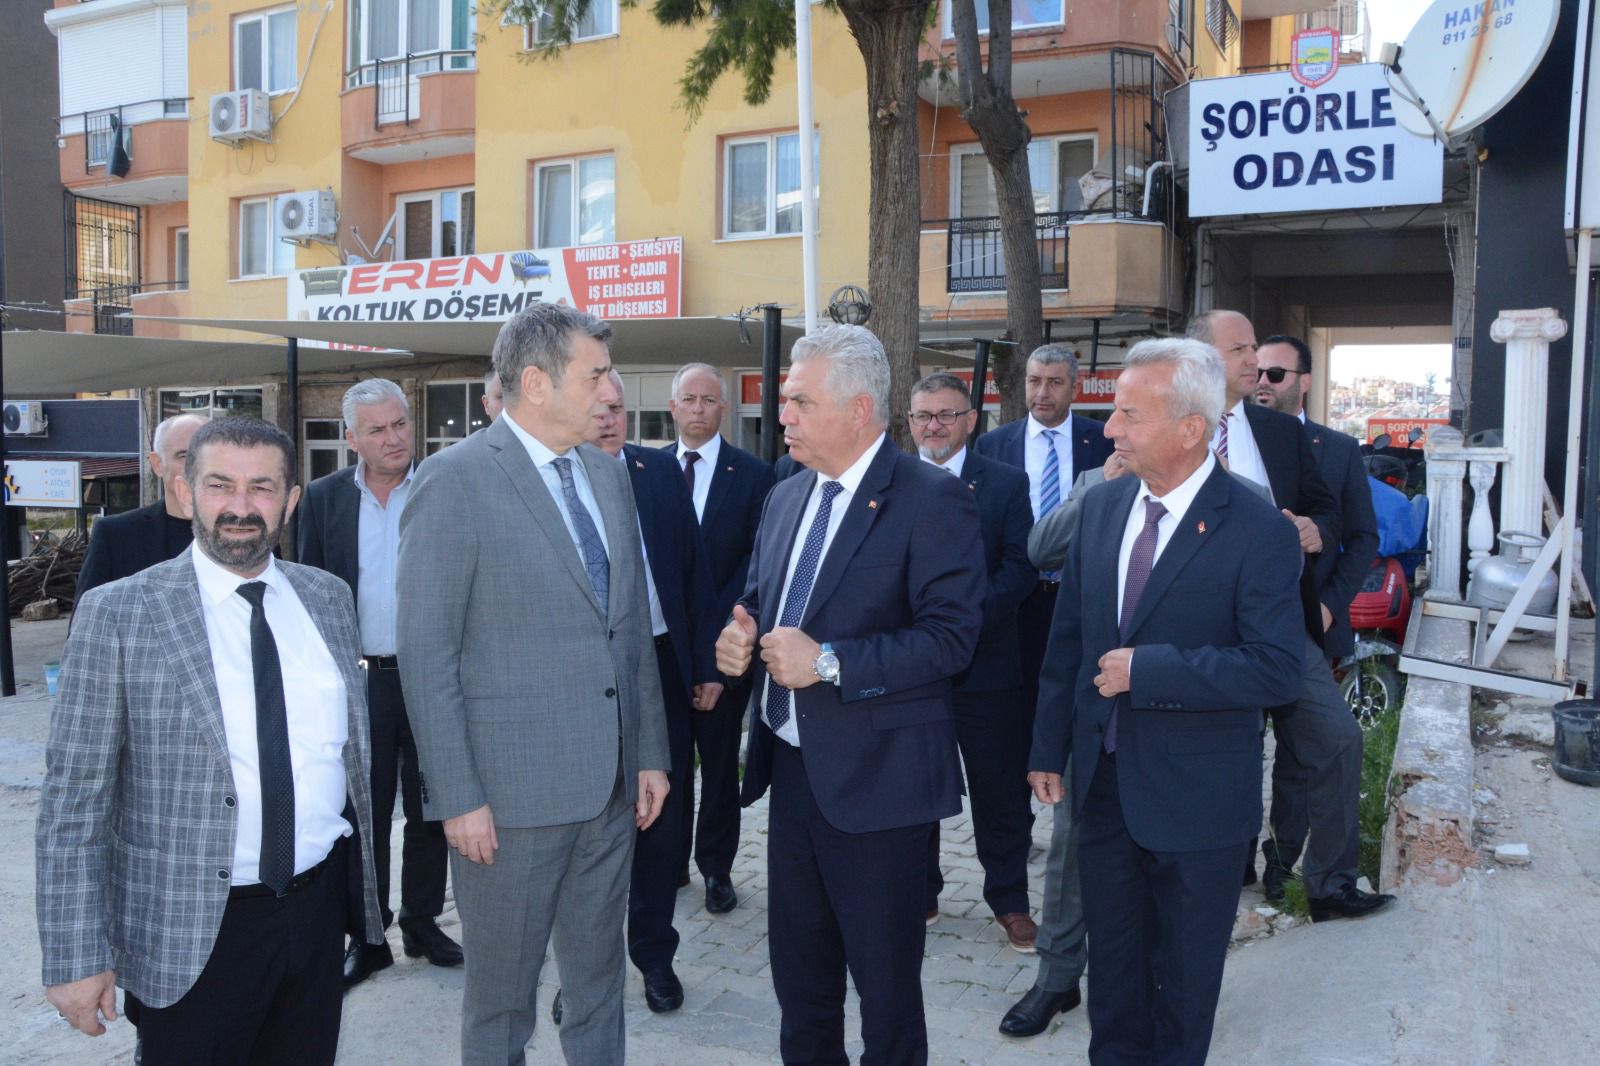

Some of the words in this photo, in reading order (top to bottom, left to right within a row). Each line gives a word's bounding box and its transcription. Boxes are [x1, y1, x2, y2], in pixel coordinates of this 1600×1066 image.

[1442, 29, 1466, 46] 811
[1494, 12, 1513, 29] 68
[1201, 87, 1397, 152] ŞOFÖRLE
[1233, 143, 1395, 190] ODASI
[307, 196, 315, 229] REGAL
[575, 245, 619, 263] MİNDER
[629, 239, 681, 260] ŞEMSİYE
[348, 254, 505, 295] EREN
[586, 264, 620, 280] TENTE
[630, 260, 667, 279] ÇADIR
[588, 285, 600, 301] İŞ
[602, 280, 665, 298] ELBİSELERİ
[317, 299, 417, 321] KOLTUK
[585, 303, 606, 318] YAT
[608, 297, 667, 318] DÖŞEMESİ
